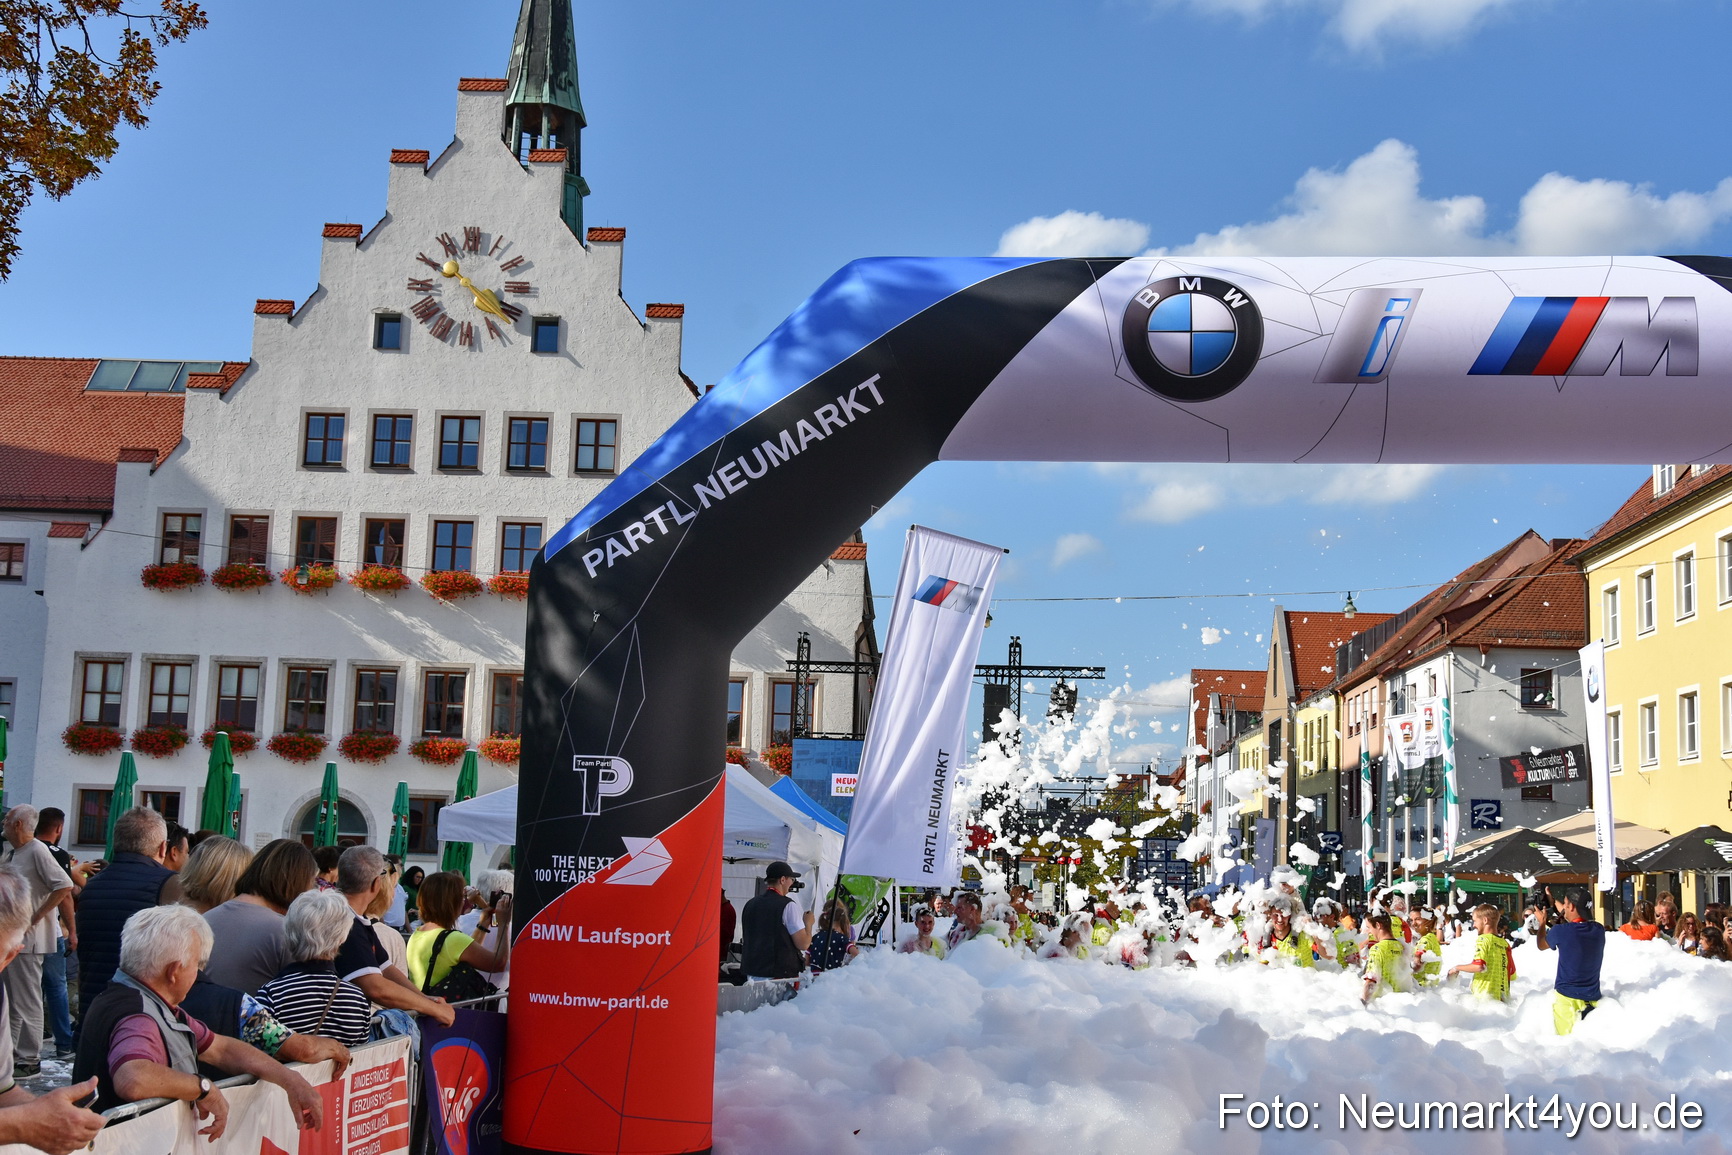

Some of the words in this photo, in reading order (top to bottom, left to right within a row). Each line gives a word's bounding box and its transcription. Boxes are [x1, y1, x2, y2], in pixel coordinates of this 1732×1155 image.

[1135, 277, 1249, 310] BMW
[581, 499, 697, 579] PARTL
[693, 373, 885, 510] NEUMARKT
[577, 759, 595, 767] Team
[1527, 766, 1566, 783] KULTURNACHT
[927, 748, 950, 829] NEUMARKT
[552, 855, 576, 869] THE
[578, 856, 614, 870] NEXT
[922, 831, 938, 874] PARTL
[534, 868, 552, 882] 100
[554, 870, 596, 884] YEARS
[531, 923, 574, 942] BMW
[577, 927, 671, 948] Laufsport
[529, 992, 669, 1011] www.bmw-partl.de
